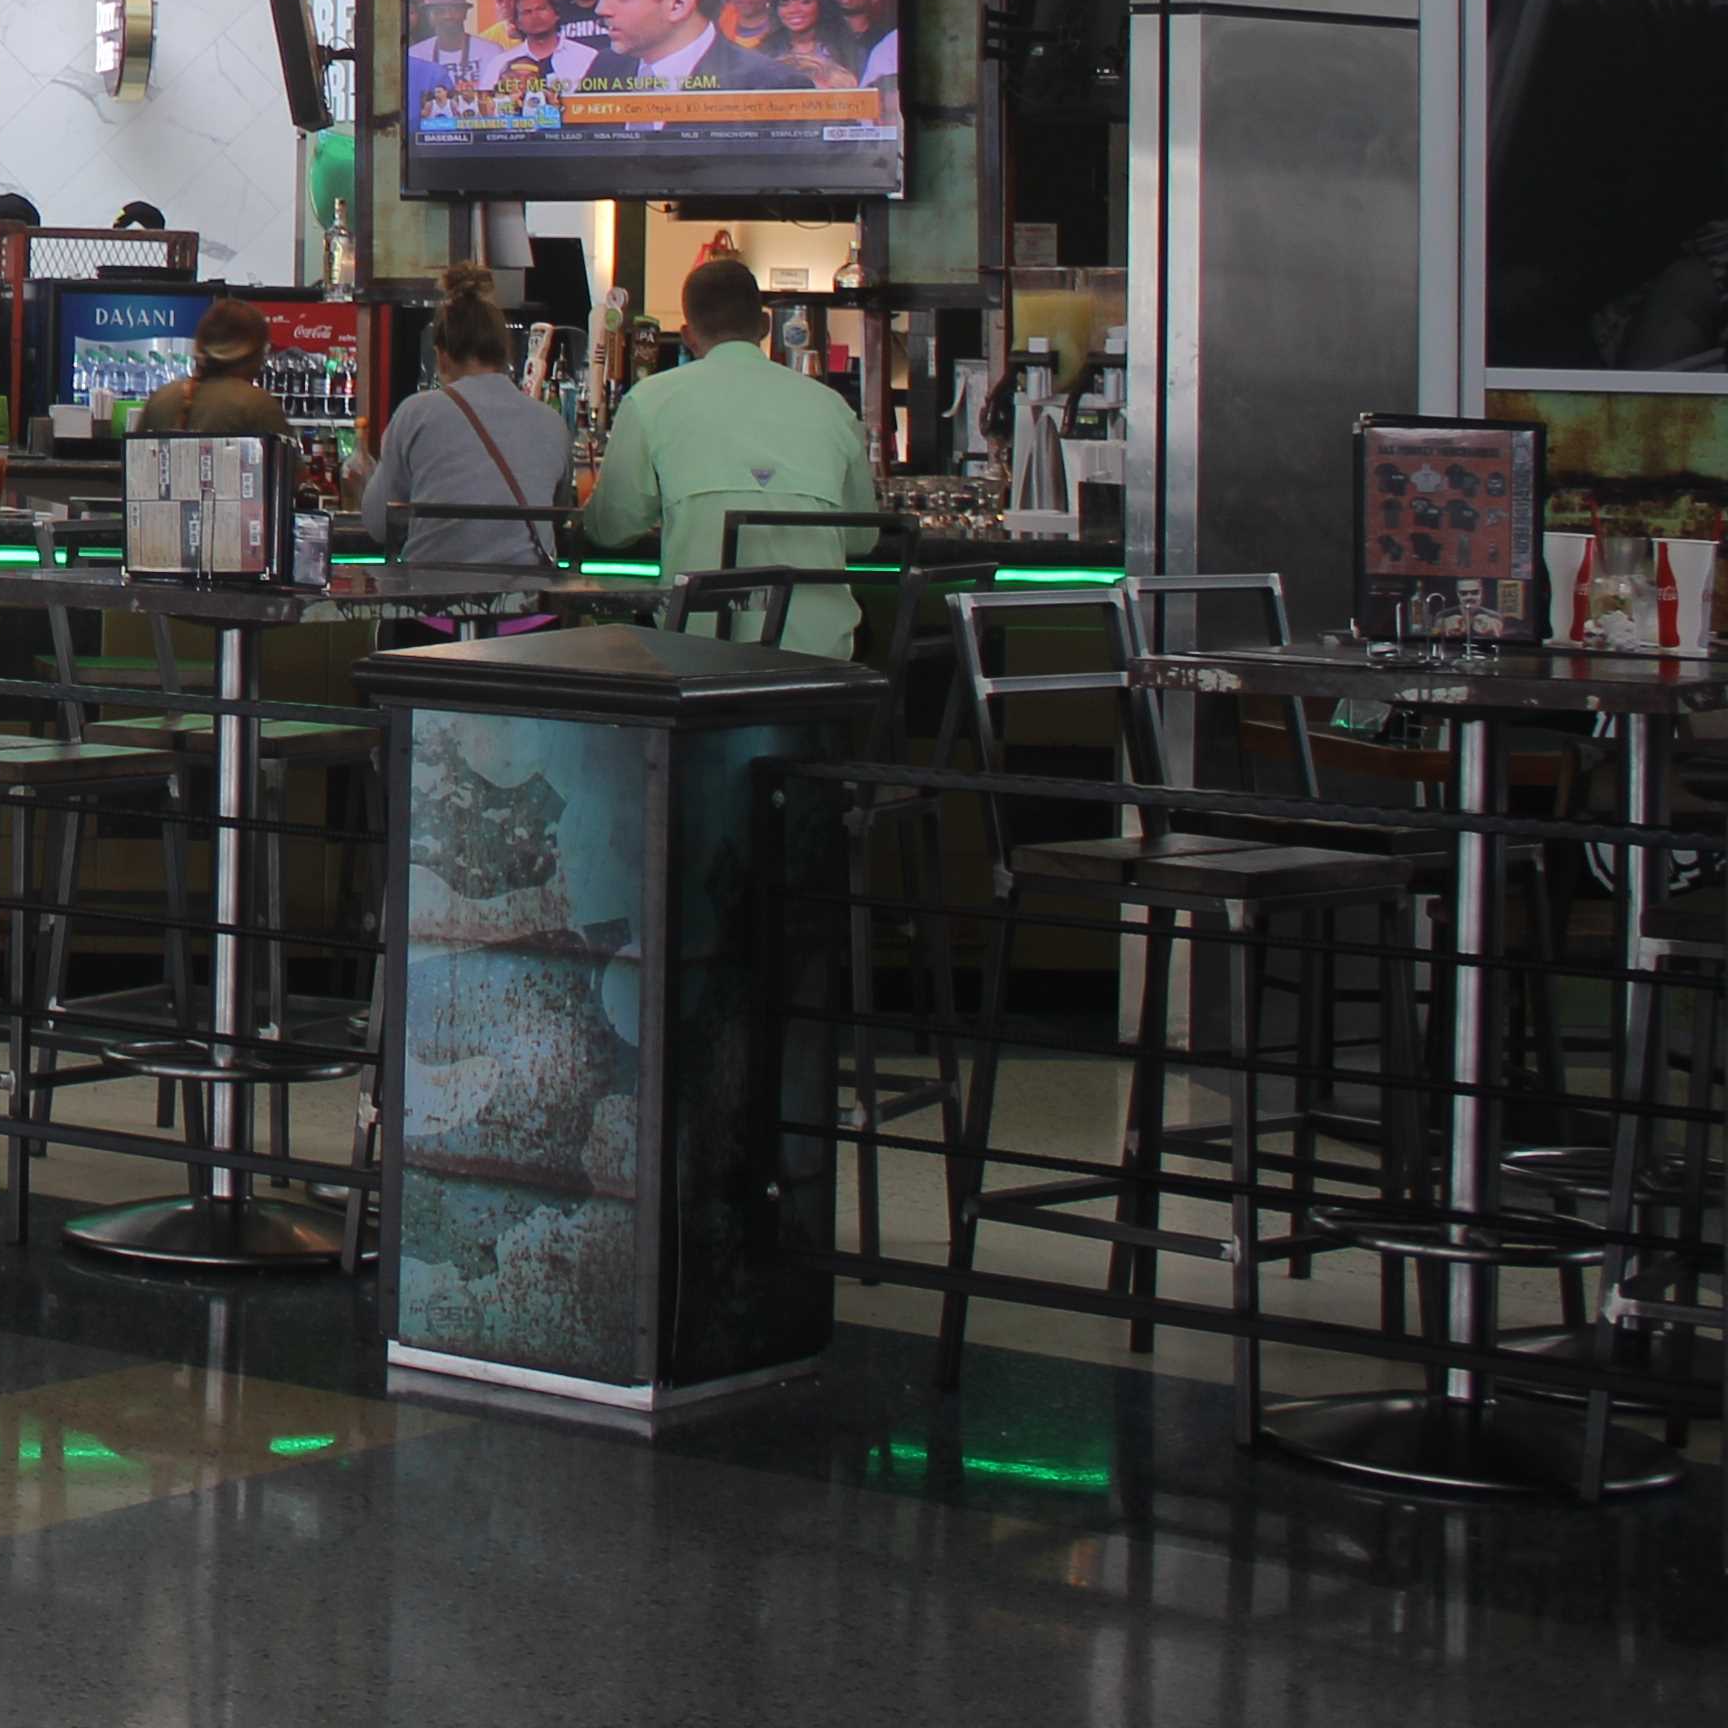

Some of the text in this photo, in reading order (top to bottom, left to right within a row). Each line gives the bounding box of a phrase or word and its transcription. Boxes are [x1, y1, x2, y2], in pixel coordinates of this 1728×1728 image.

[497, 79, 521, 93] LET
[526, 79, 547, 91] ME
[577, 77, 608, 91] JOIN
[612, 77, 623, 90] A
[626, 75, 671, 90] SUPE
[95, 307, 175, 328] DASANI
